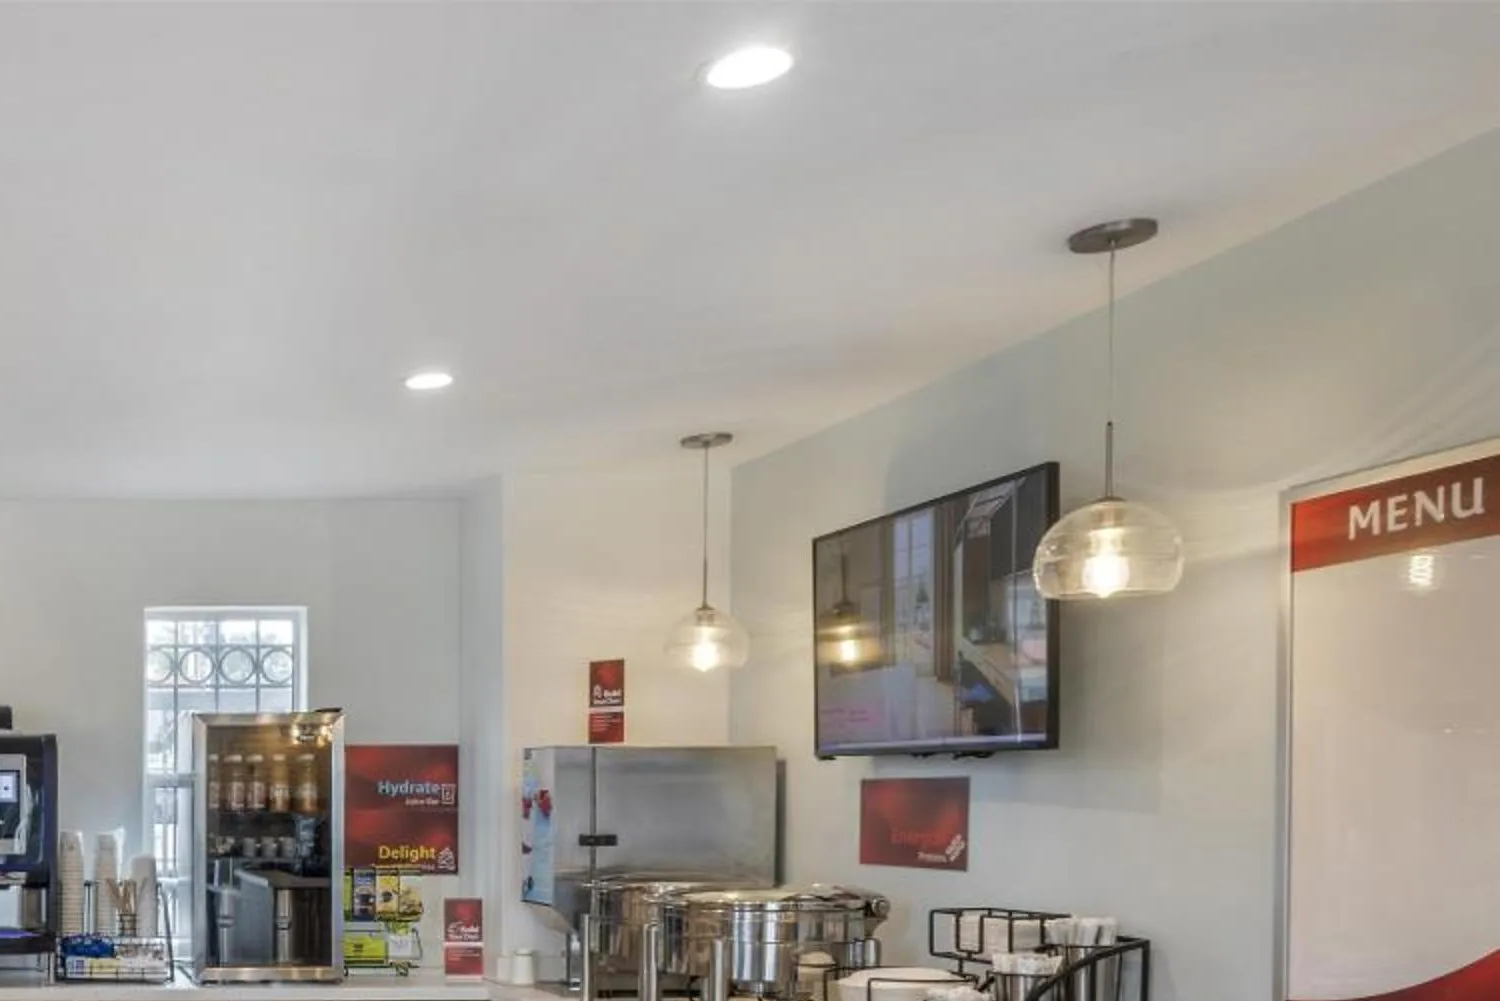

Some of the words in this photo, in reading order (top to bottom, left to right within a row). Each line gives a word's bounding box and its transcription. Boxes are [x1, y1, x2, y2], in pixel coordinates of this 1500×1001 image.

[1348, 476, 1486, 541] MENU
[377, 779, 441, 797] Hydrate
[378, 845, 436, 863] Delight
